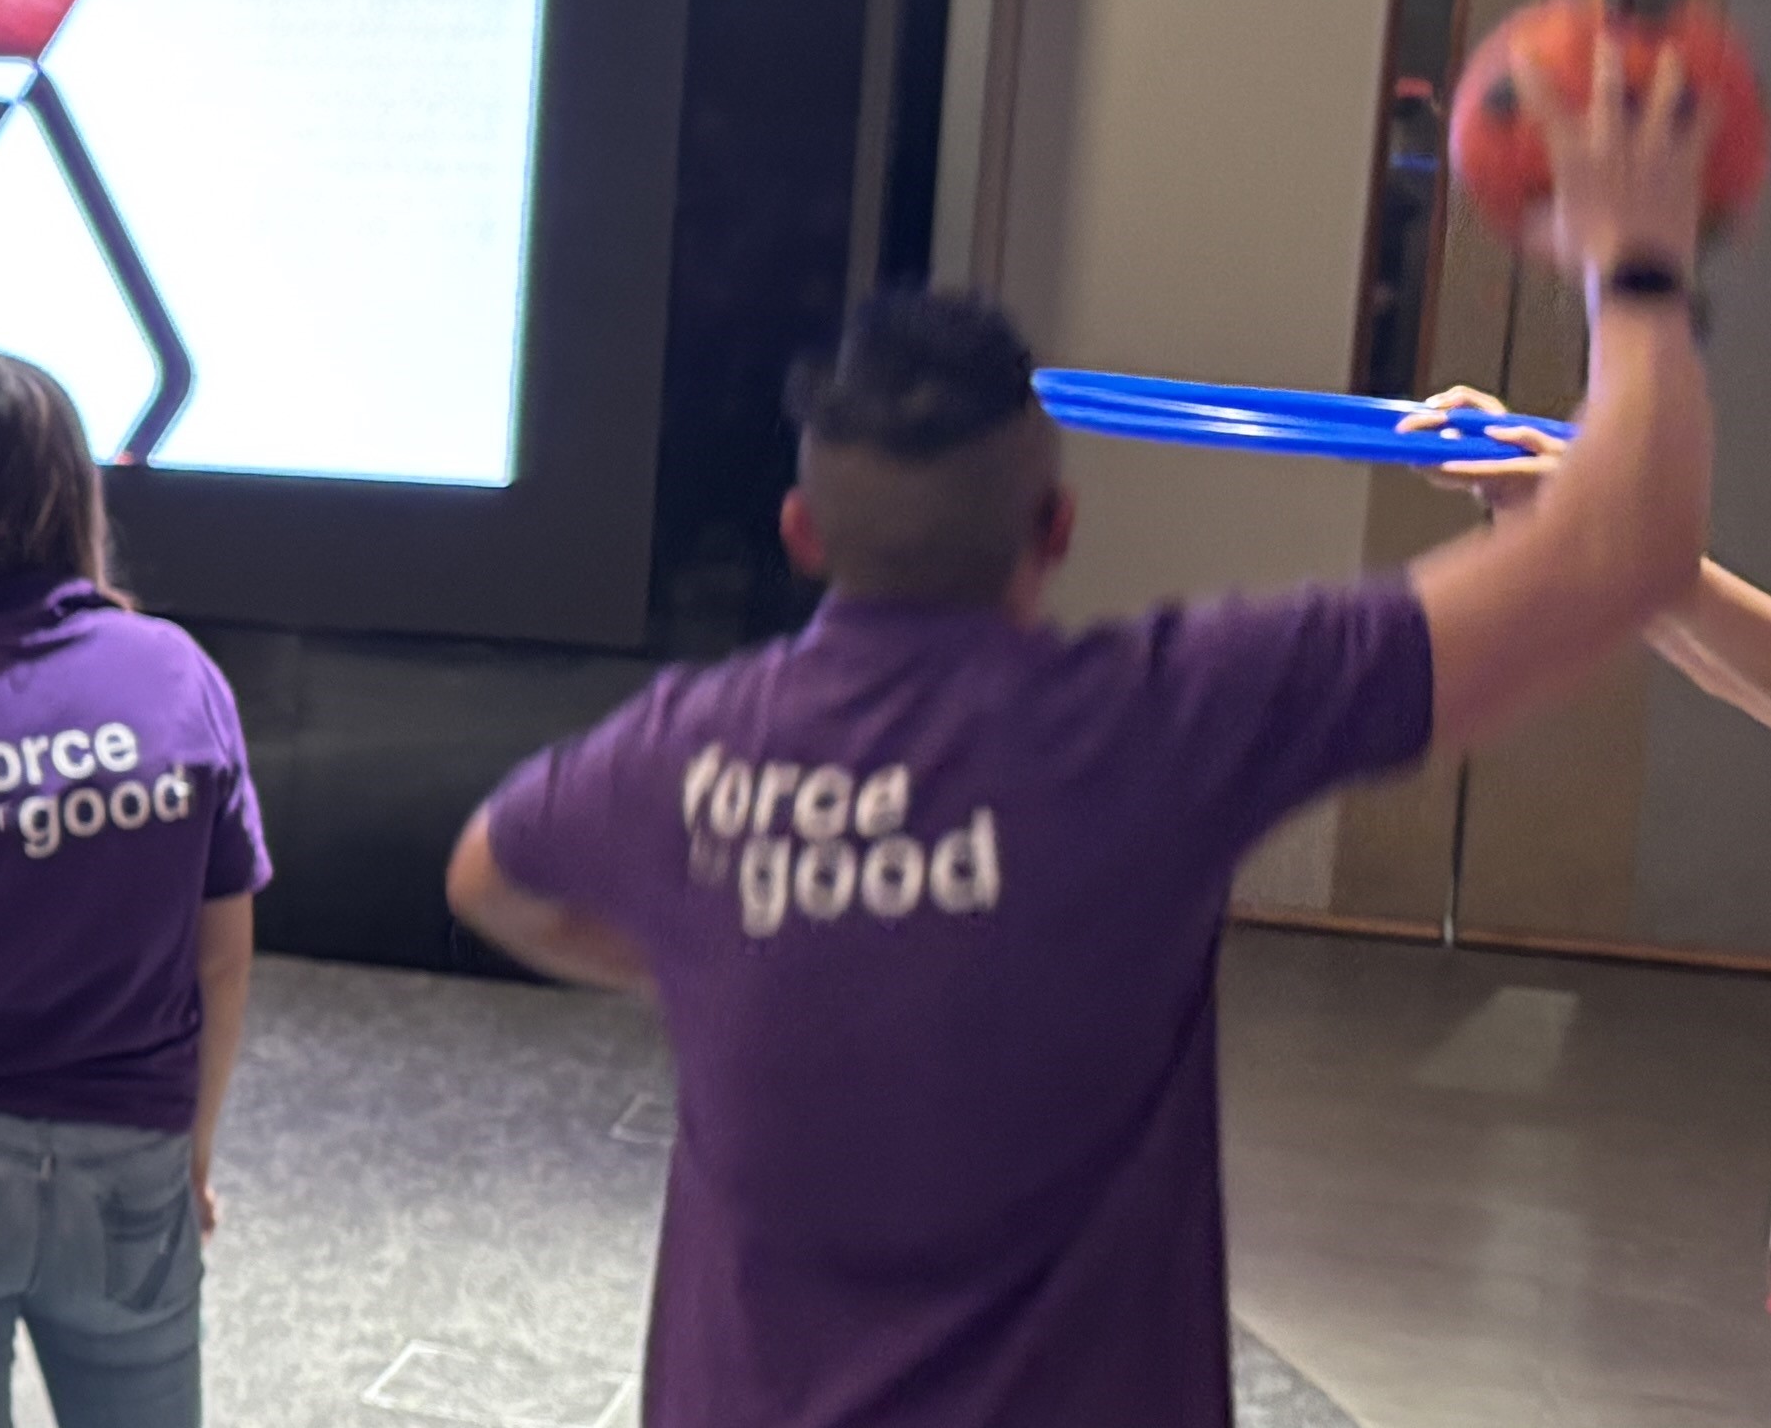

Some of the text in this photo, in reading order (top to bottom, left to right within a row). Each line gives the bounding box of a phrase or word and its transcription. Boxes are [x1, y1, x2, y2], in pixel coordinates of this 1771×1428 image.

[18, 760, 191, 859] good
[682, 740, 909, 842] force
[738, 804, 1000, 939] good
